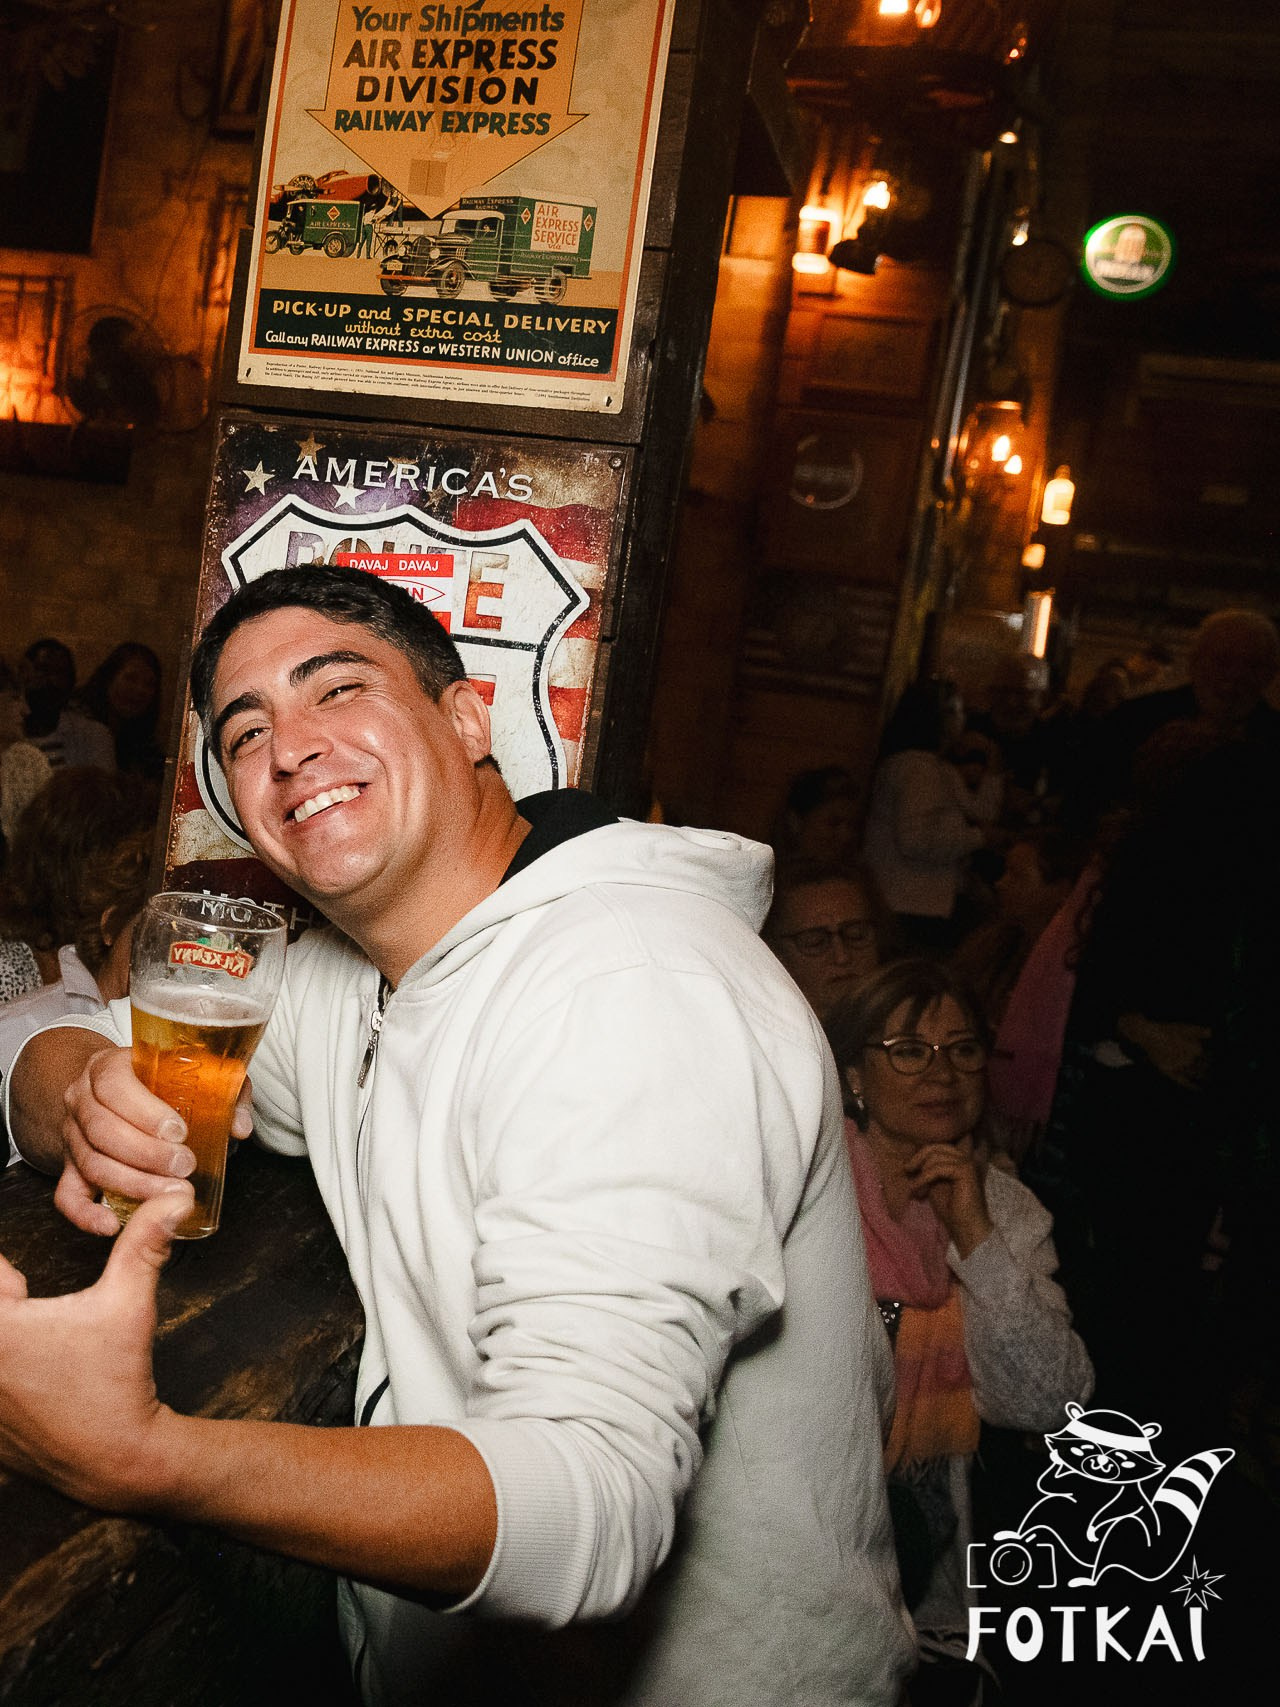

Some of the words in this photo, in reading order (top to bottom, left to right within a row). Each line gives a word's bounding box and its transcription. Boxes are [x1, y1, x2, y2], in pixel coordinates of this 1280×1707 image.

[352, 6, 412, 32] Your
[420, 4, 565, 37] Shipments
[343, 39, 402, 72] AIR
[412, 39, 559, 74] EXPRESS
[356, 76, 539, 105] DIVISION
[335, 109, 434, 133] RAILWAY
[440, 111, 552, 137] EXPRESS
[535, 218, 579, 233] EXPRESS
[537, 205, 559, 217] AIR
[533, 230, 577, 246] SERVICE
[272, 300, 352, 318] PICK-UP
[357, 307, 392, 321] and
[402, 308, 495, 328] SPECIAL
[503, 314, 612, 335] DELIVERY
[345, 321, 401, 336] without
[410, 325, 455, 341] extra
[462, 329, 503, 344] cost
[265, 330, 287, 344] Call
[286, 334, 309, 348] any
[310, 334, 364, 350] RAILWAY
[365, 337, 421, 354] EXPRESS
[422, 346, 435, 354] or
[438, 342, 501, 359] WESTERN
[505, 348, 555, 363] UNION
[557, 352, 600, 367] office
[292, 454, 534, 502] AMERICA'S
[350, 559, 389, 571] DAVAJ
[399, 560, 439, 571] DAVAJ
[201, 889, 314, 930] MOTH
